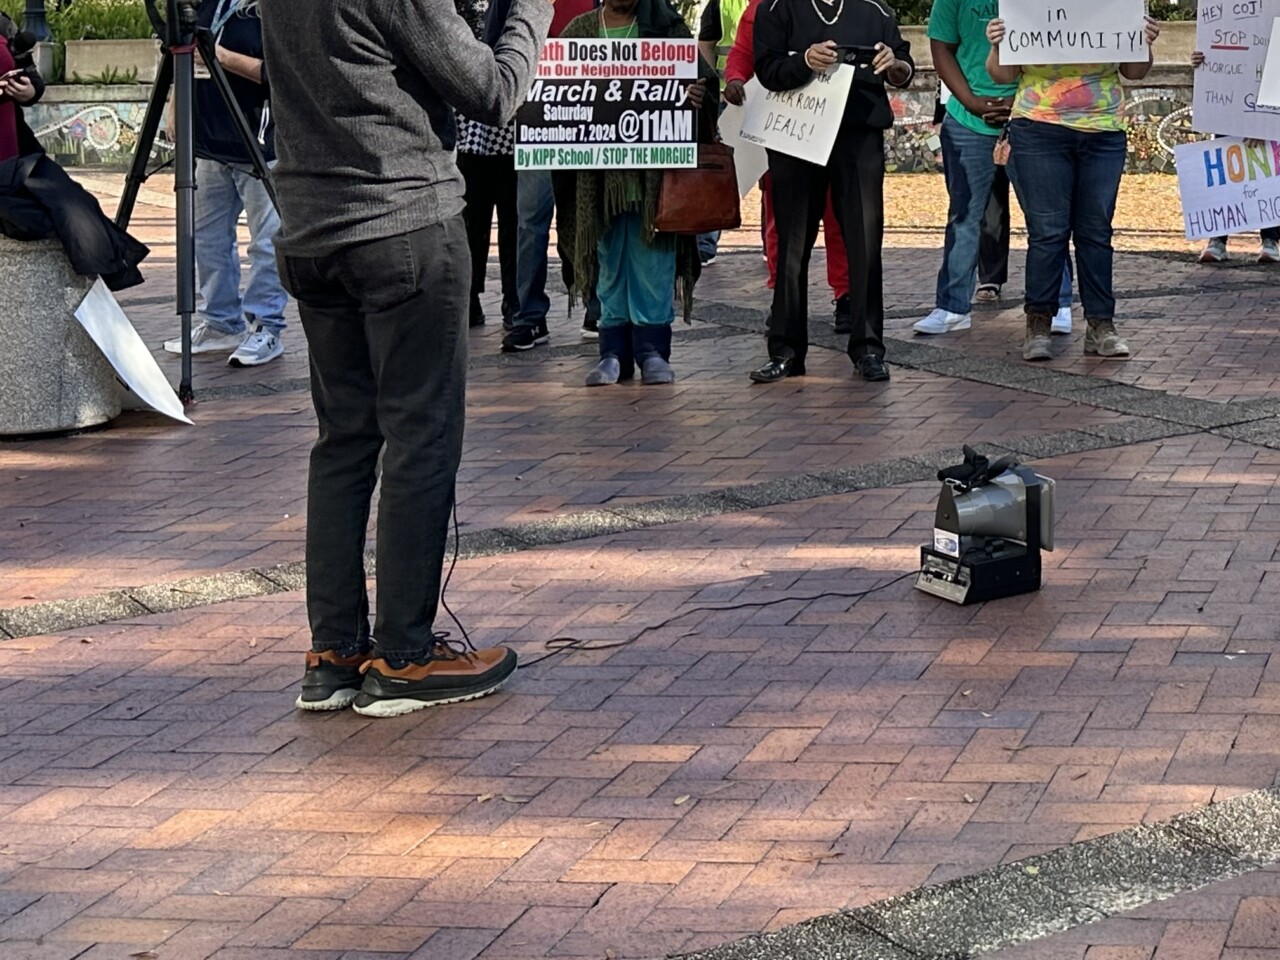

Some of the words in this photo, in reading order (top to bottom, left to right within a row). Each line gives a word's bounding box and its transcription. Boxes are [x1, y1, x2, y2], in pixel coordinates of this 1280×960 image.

[1047, 6, 1068, 23] in
[1202, 4, 1223, 22] HEY
[1233, 0, 1263, 16] COJ!
[1211, 29, 1247, 45] STOP
[568, 42, 607, 61] Does
[611, 42, 637, 61] Not
[641, 42, 696, 64] Belong
[538, 65, 551, 76] In
[554, 64, 578, 76] Our
[581, 64, 676, 78] Neighborhood
[1201, 61, 1243, 75] MORGUE
[526, 80, 597, 102] March
[604, 80, 623, 102] &
[630, 80, 690, 107] Rally
[1205, 90, 1234, 106] THAN
[543, 104, 593, 122] Saturday
[520, 124, 577, 142] December
[579, 124, 588, 142] 7,
[589, 124, 616, 141] 2024
[618, 109, 692, 142] @11AM
[763, 112, 815, 143] DEALS!
[517, 148, 531, 167] By
[532, 148, 556, 166] KIPP
[558, 147, 593, 165] School
[602, 147, 628, 165] STOP
[630, 147, 648, 164] THE
[650, 147, 694, 164] MORGUE!
[1242, 184, 1258, 199] for
[1188, 201, 1248, 237] HUMAN
